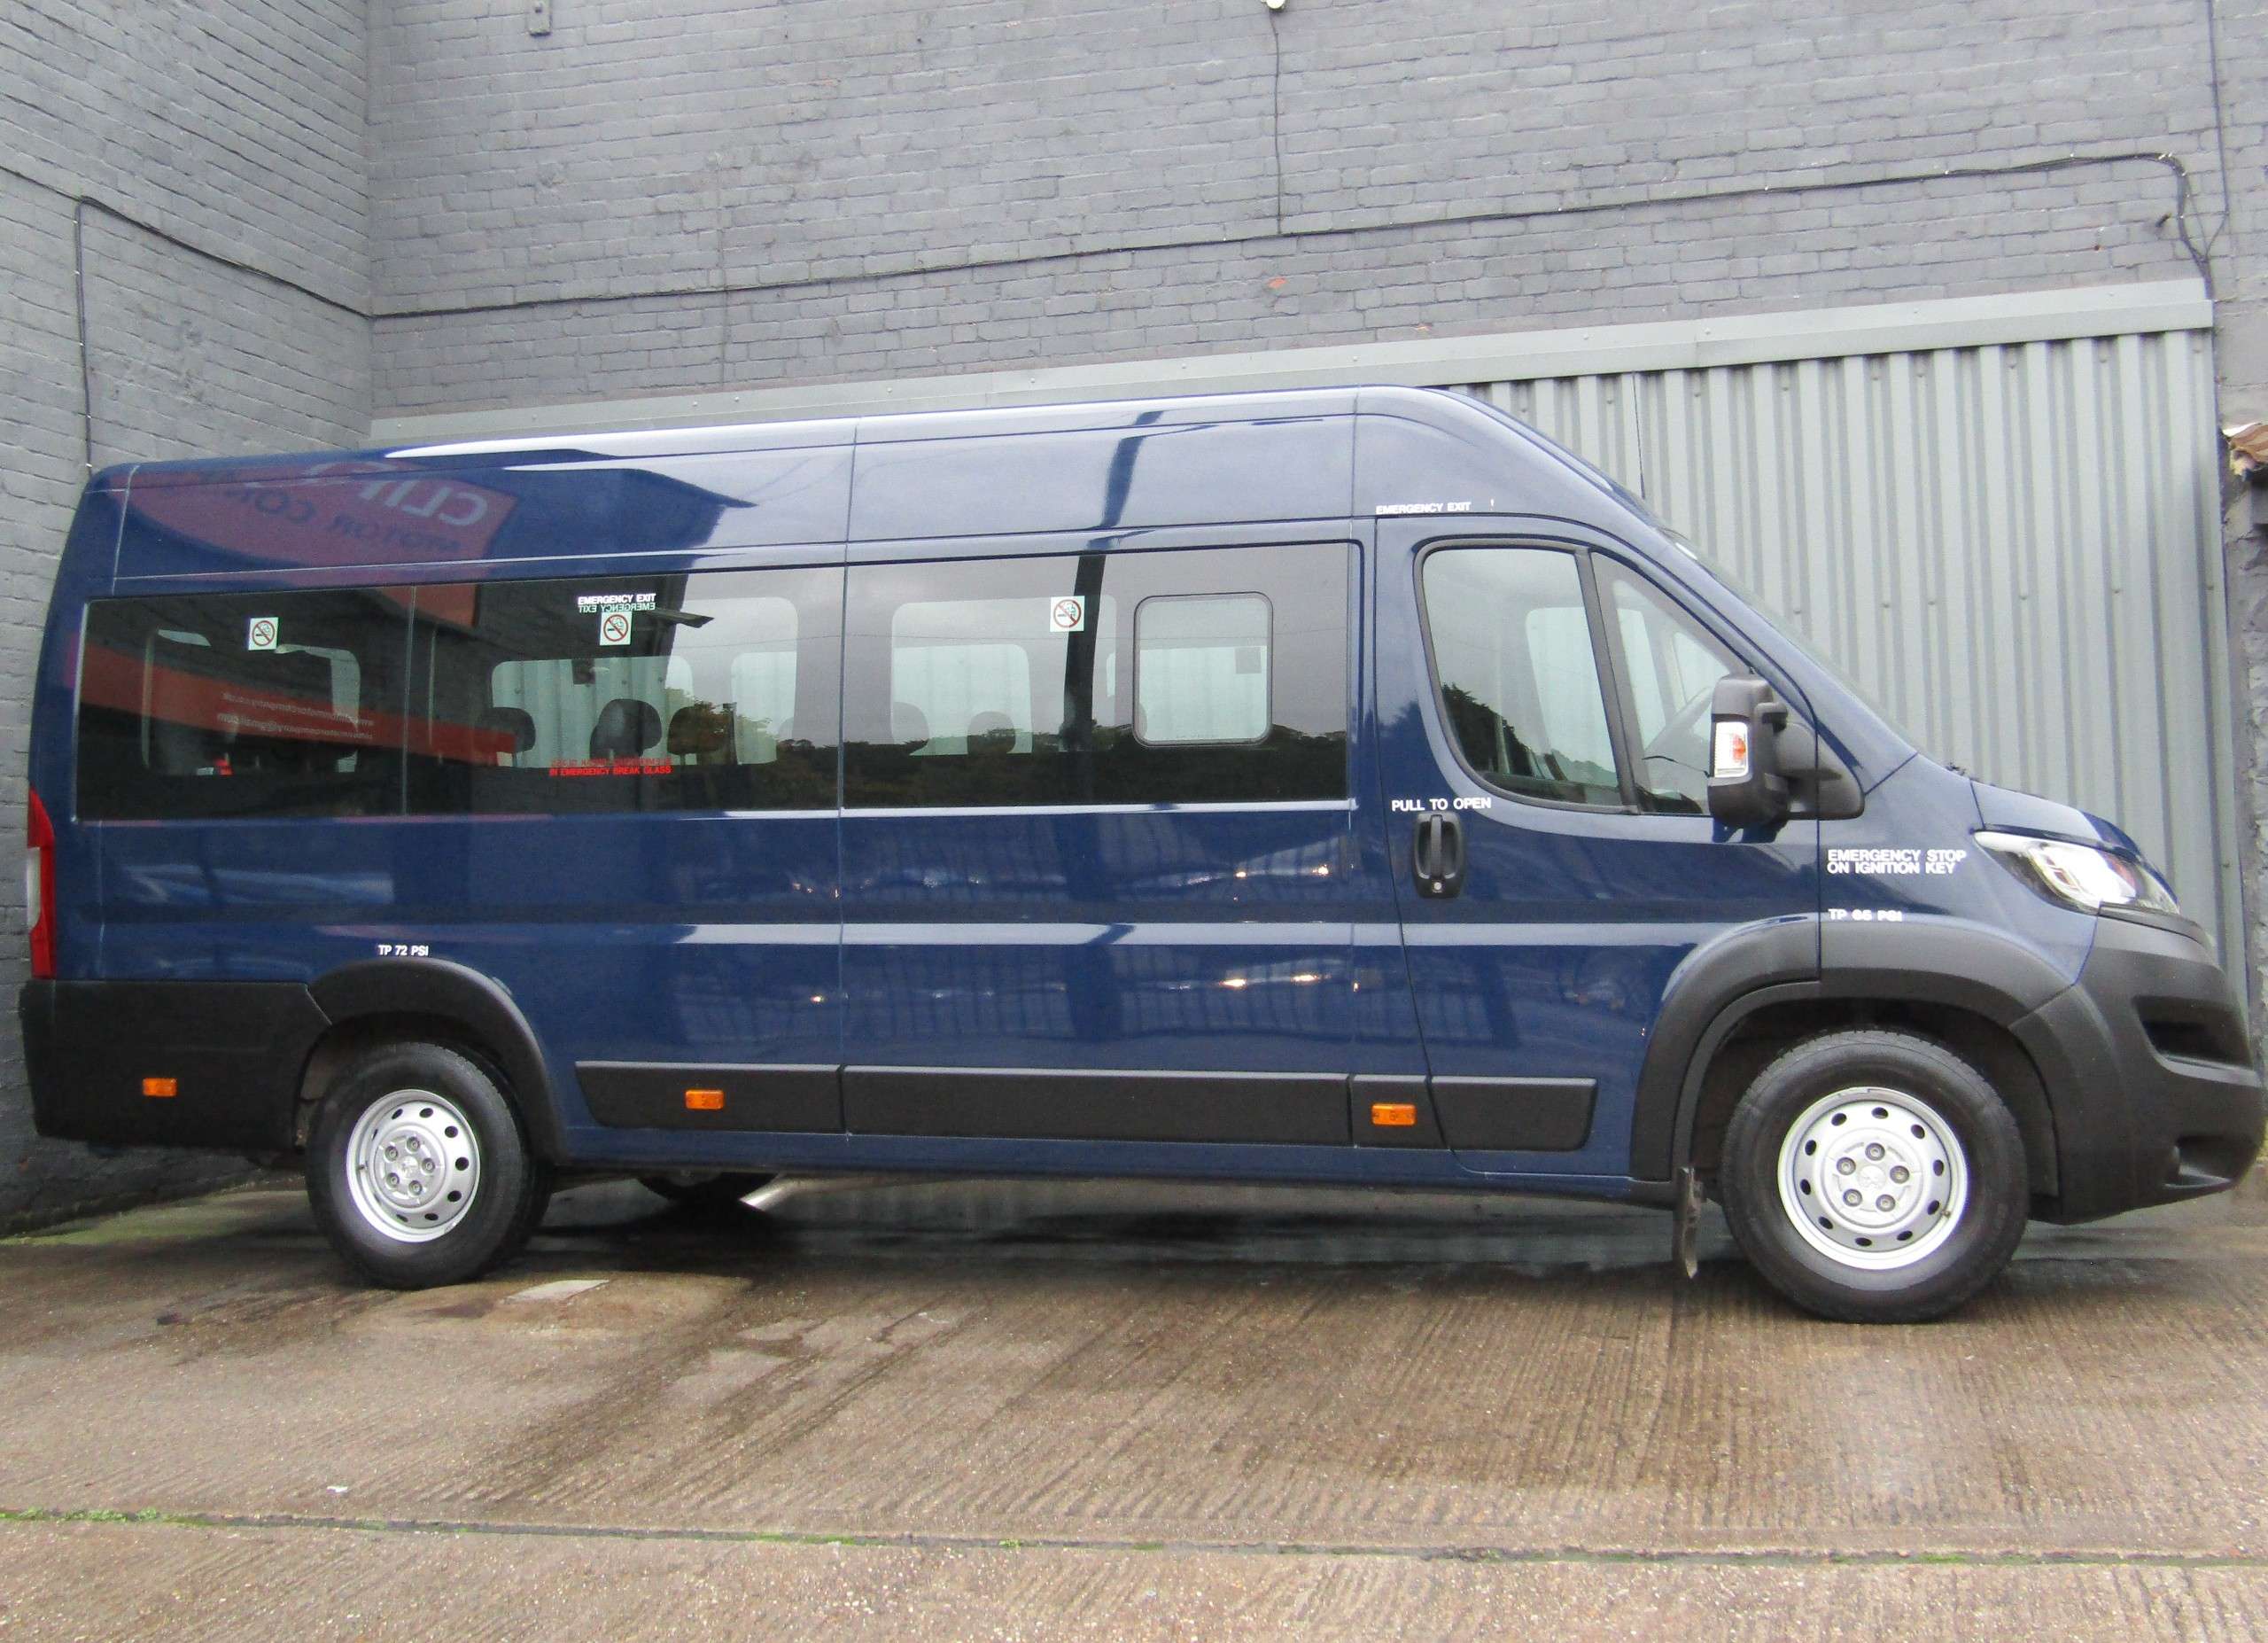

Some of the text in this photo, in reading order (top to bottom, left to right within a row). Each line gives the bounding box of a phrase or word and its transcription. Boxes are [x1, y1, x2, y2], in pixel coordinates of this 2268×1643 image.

[1375, 502, 1472, 515] EMERGENCY EXIT
[578, 593, 656, 605] EMERGENCY EXIT
[561, 767, 610, 776] EMERGENCY
[643, 765, 672, 775] GLASS
[1391, 798, 1492, 811] PULL TO OPEN
[1828, 849, 1967, 862] EMERGENCY STOP
[1827, 861, 1956, 875] ON IGNITION KEY
[1828, 908, 1848, 921] TP
[378, 945, 429, 955] TP 72 PSI
